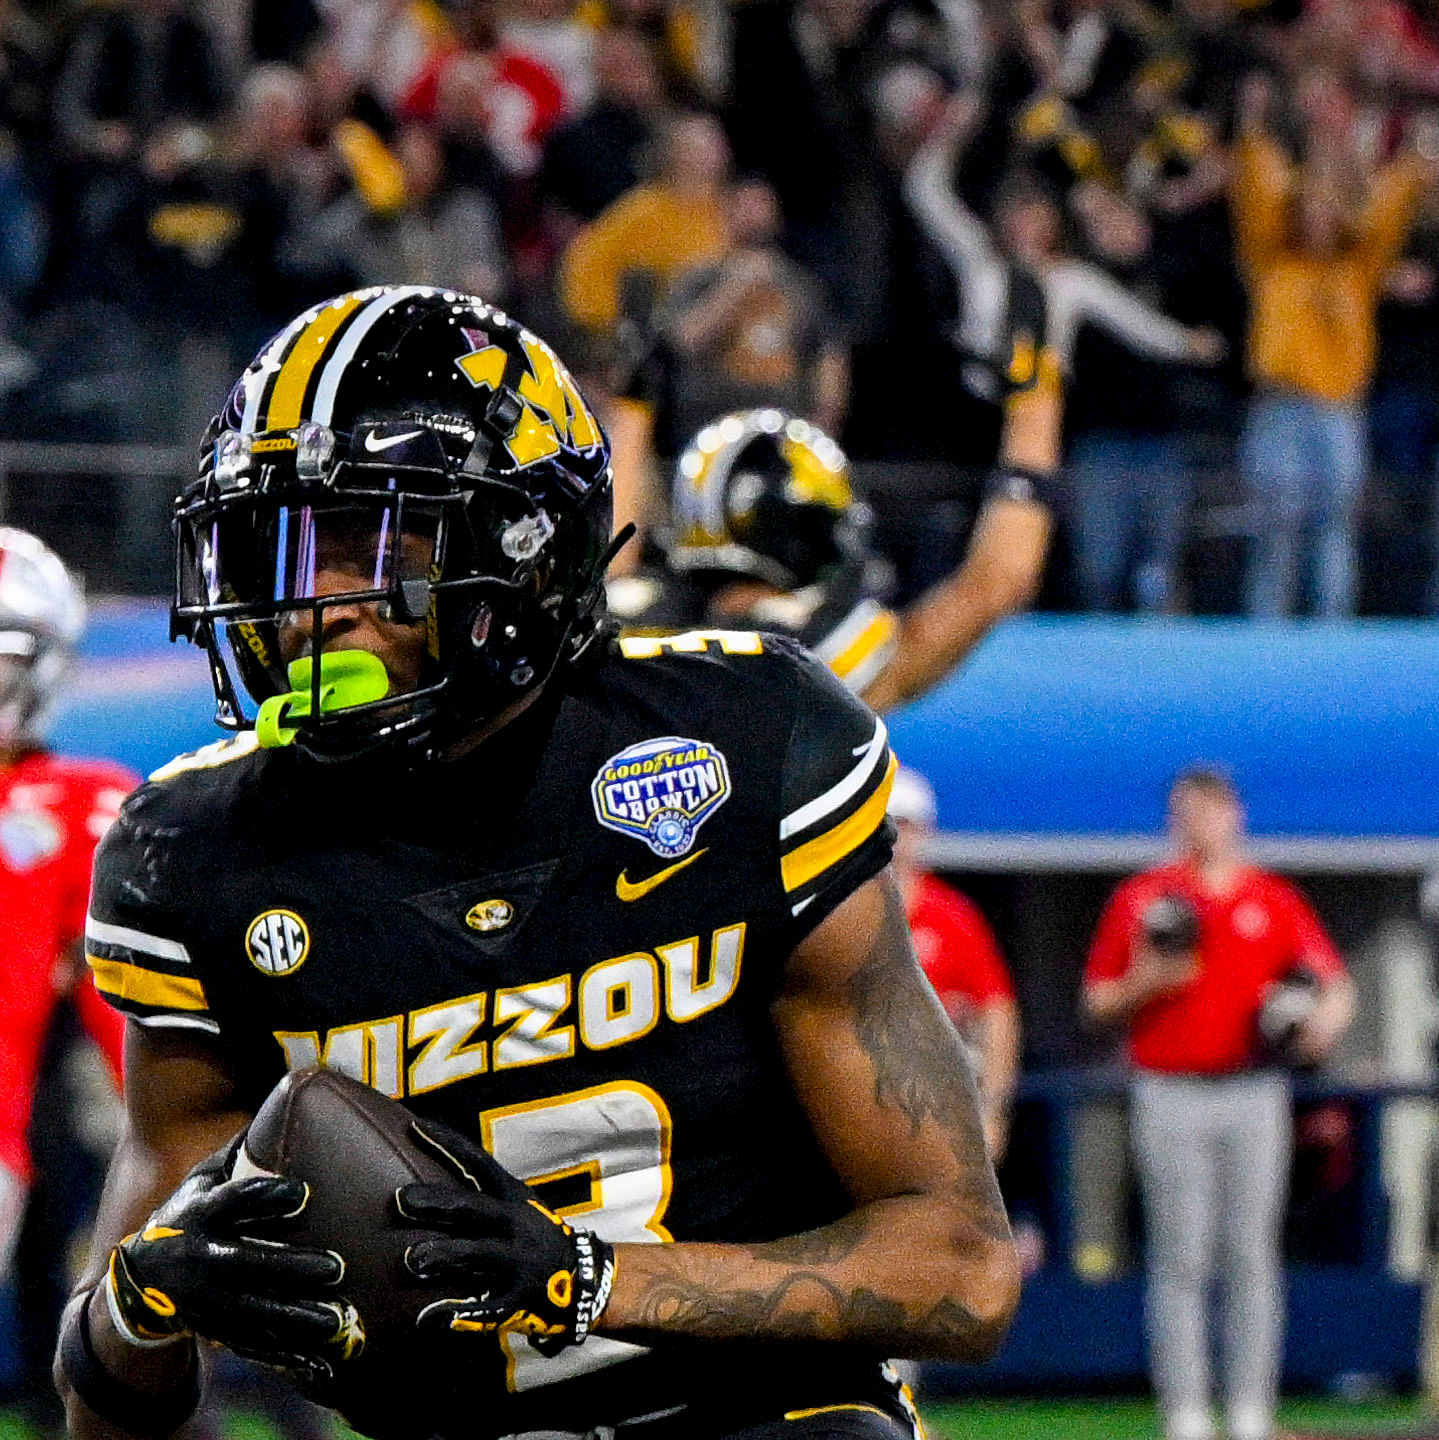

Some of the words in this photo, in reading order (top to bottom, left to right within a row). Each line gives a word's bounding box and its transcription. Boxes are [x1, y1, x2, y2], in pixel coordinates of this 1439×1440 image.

[604, 747, 708, 781] GOODYEAR
[605, 762, 719, 818] COTTON
[628, 789, 700, 822] BOWL
[250, 913, 304, 973] SEC
[272, 921, 748, 1099] MIZZOU
